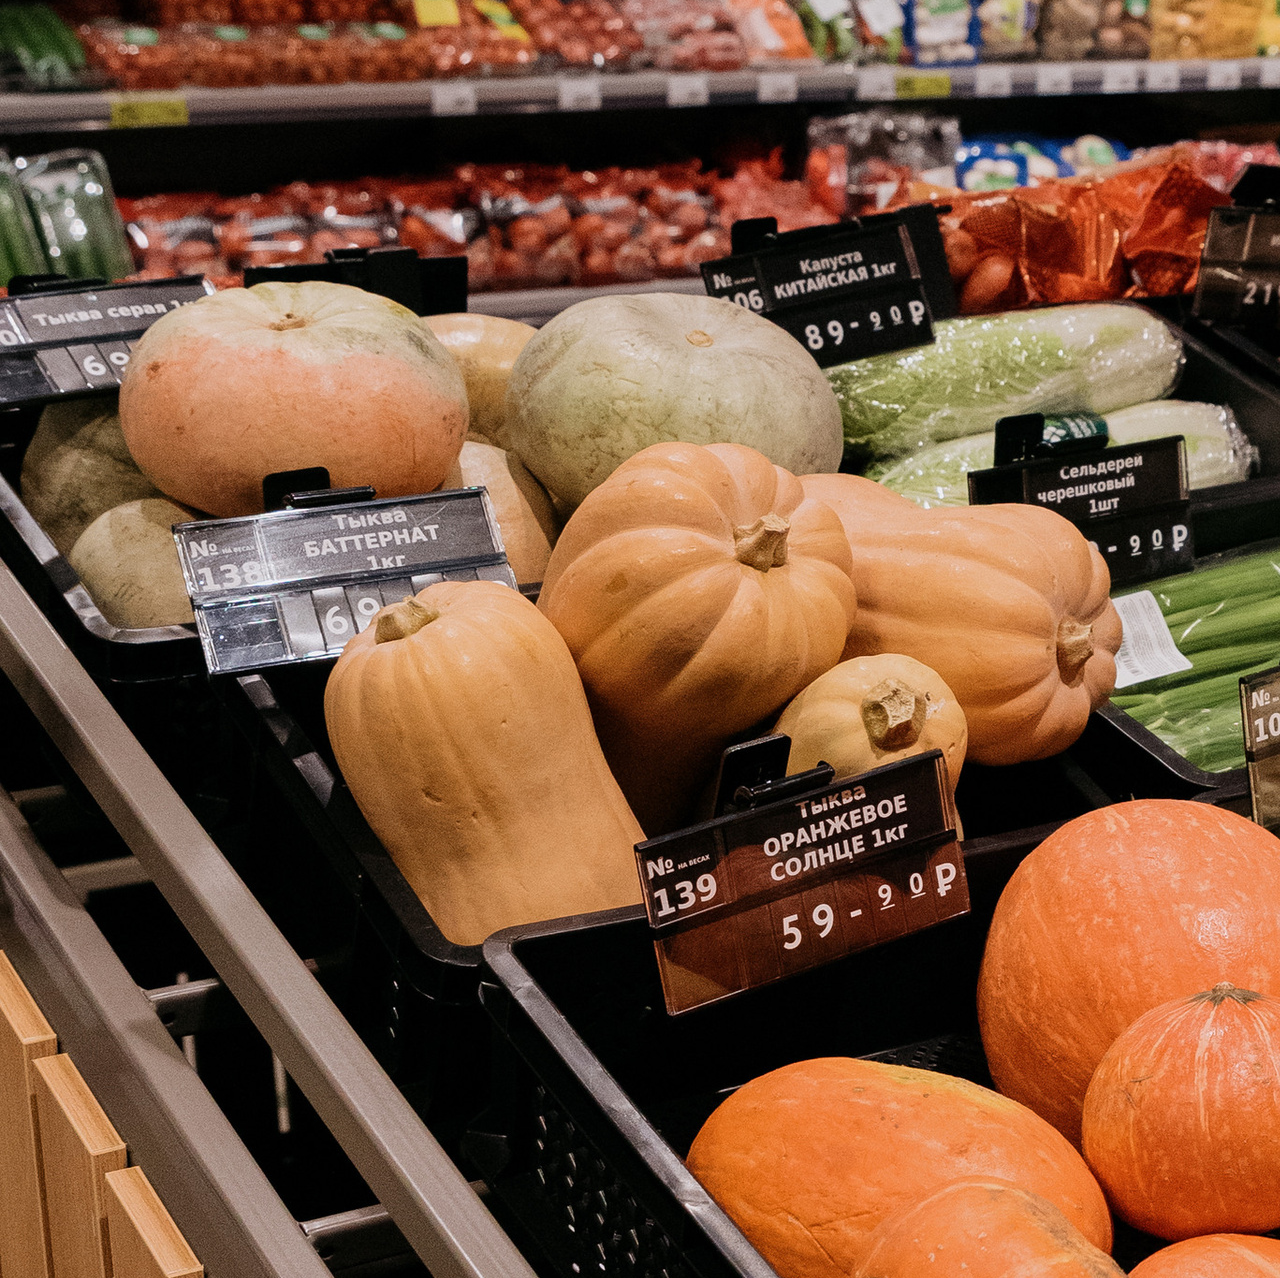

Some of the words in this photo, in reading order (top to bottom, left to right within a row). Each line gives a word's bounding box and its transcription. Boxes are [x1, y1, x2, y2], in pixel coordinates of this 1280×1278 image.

[799, 251, 863, 274] Капуста
[774, 266, 869, 300] КИТАЙСКАЯ
[871, 261, 897, 278] 1кг
[33, 309, 104, 327] Тыква
[107, 302, 168, 319] серая
[1059, 453, 1143, 481] Сельдерей
[1037, 473, 1136, 503] черешковый
[1089, 497, 1120, 513] 1шт
[332, 510, 408, 530] Тыква
[191, 540, 219, 559] №
[304, 524, 440, 558] БАТТЕРНАТ
[198, 560, 264, 592] 138
[366, 554, 406, 571] 1кг
[1252, 688, 1271, 709] №
[795, 785, 866, 819] Тыква
[763, 794, 908, 857] ОРАНЖЕВОЕ
[647, 856, 674, 879] №
[689, 853, 711, 868] ВЕСАХ
[770, 834, 865, 881] СОЛНЦЕ
[872, 823, 909, 849] 1кг
[654, 873, 717, 917] 139
